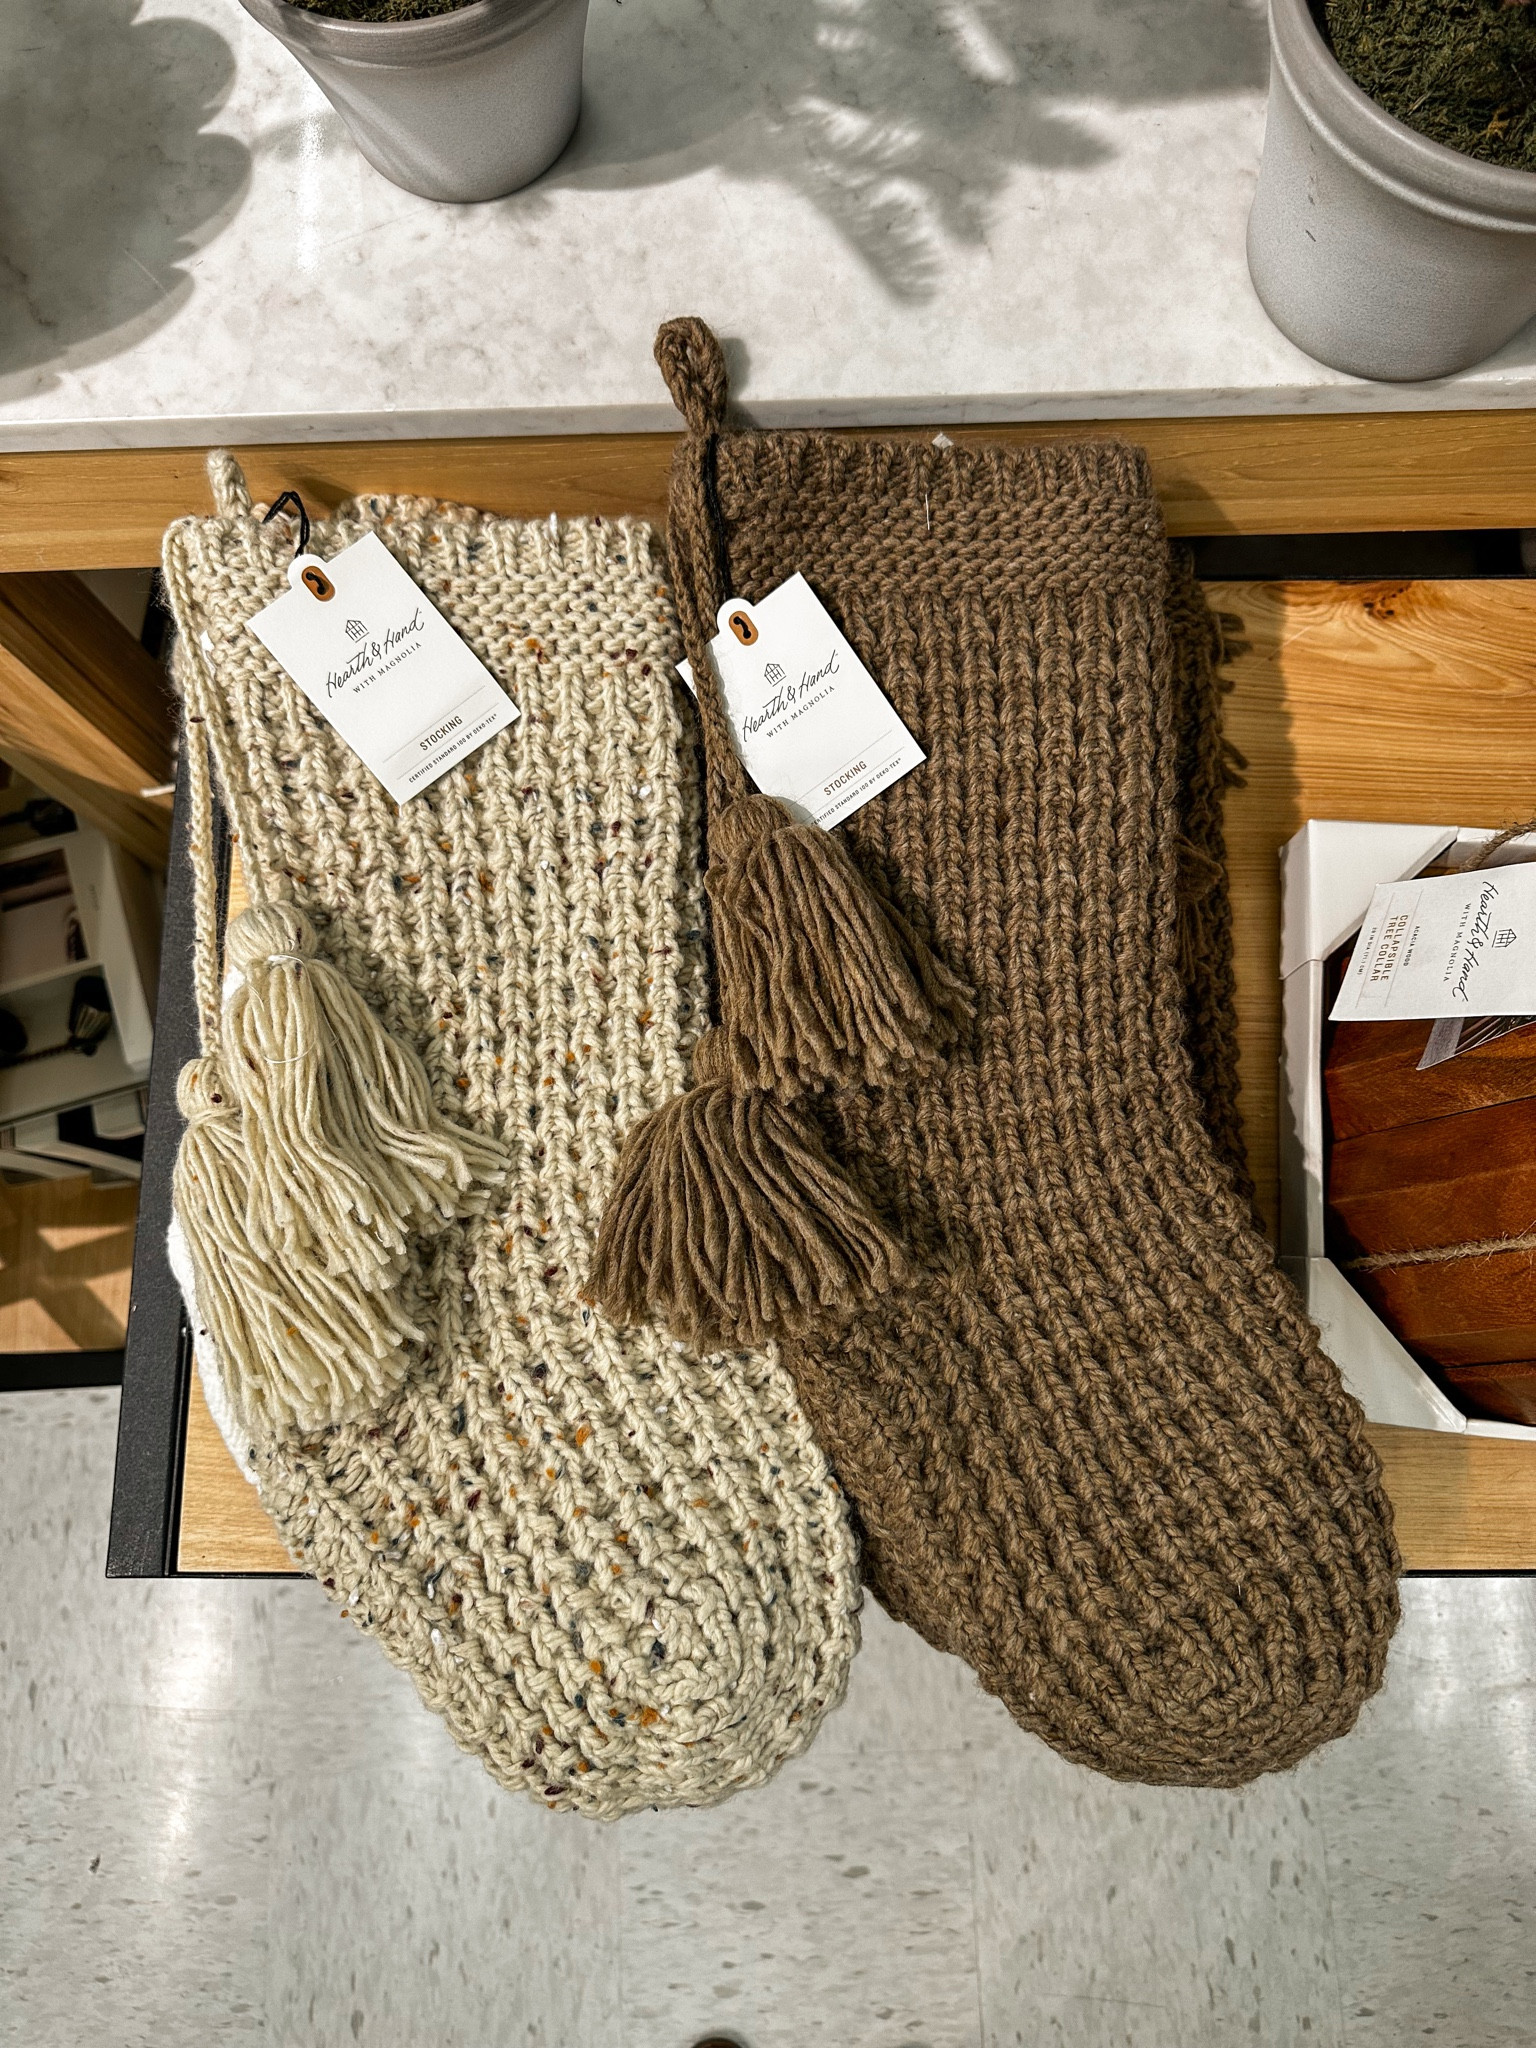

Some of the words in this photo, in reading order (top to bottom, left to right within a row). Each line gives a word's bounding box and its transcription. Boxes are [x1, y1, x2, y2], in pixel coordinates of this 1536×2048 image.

[326, 642, 373, 698] Hearth
[371, 642, 382, 659] &
[353, 675, 377, 694] WITH
[377, 642, 422, 677] MAGNOLIA
[742, 686, 789, 742] Hearth
[786, 685, 797, 704] &
[766, 721, 789, 739] WITH
[790, 685, 835, 720] MAGNOLIA
[419, 715, 463, 751] STOCKING
[409, 763, 433, 783] CERTIFIED
[433, 745, 457, 765] STANDARD
[823, 760, 867, 796] STOCKING
[835, 790, 859, 810] STANDARD
[1384, 916, 1398, 940] TREE
[1458, 903, 1471, 931] WITH
[1470, 881, 1499, 939] Hearth
[1381, 914, 1408, 981] COLLAPSIBLE
[1410, 925, 1420, 947] ACACIA
[1467, 937, 1485, 950] &
[1370, 943, 1390, 981] COLLAR
[1403, 948, 1414, 967] WOOD
[1443, 931, 1463, 982] MAGNOLIA
